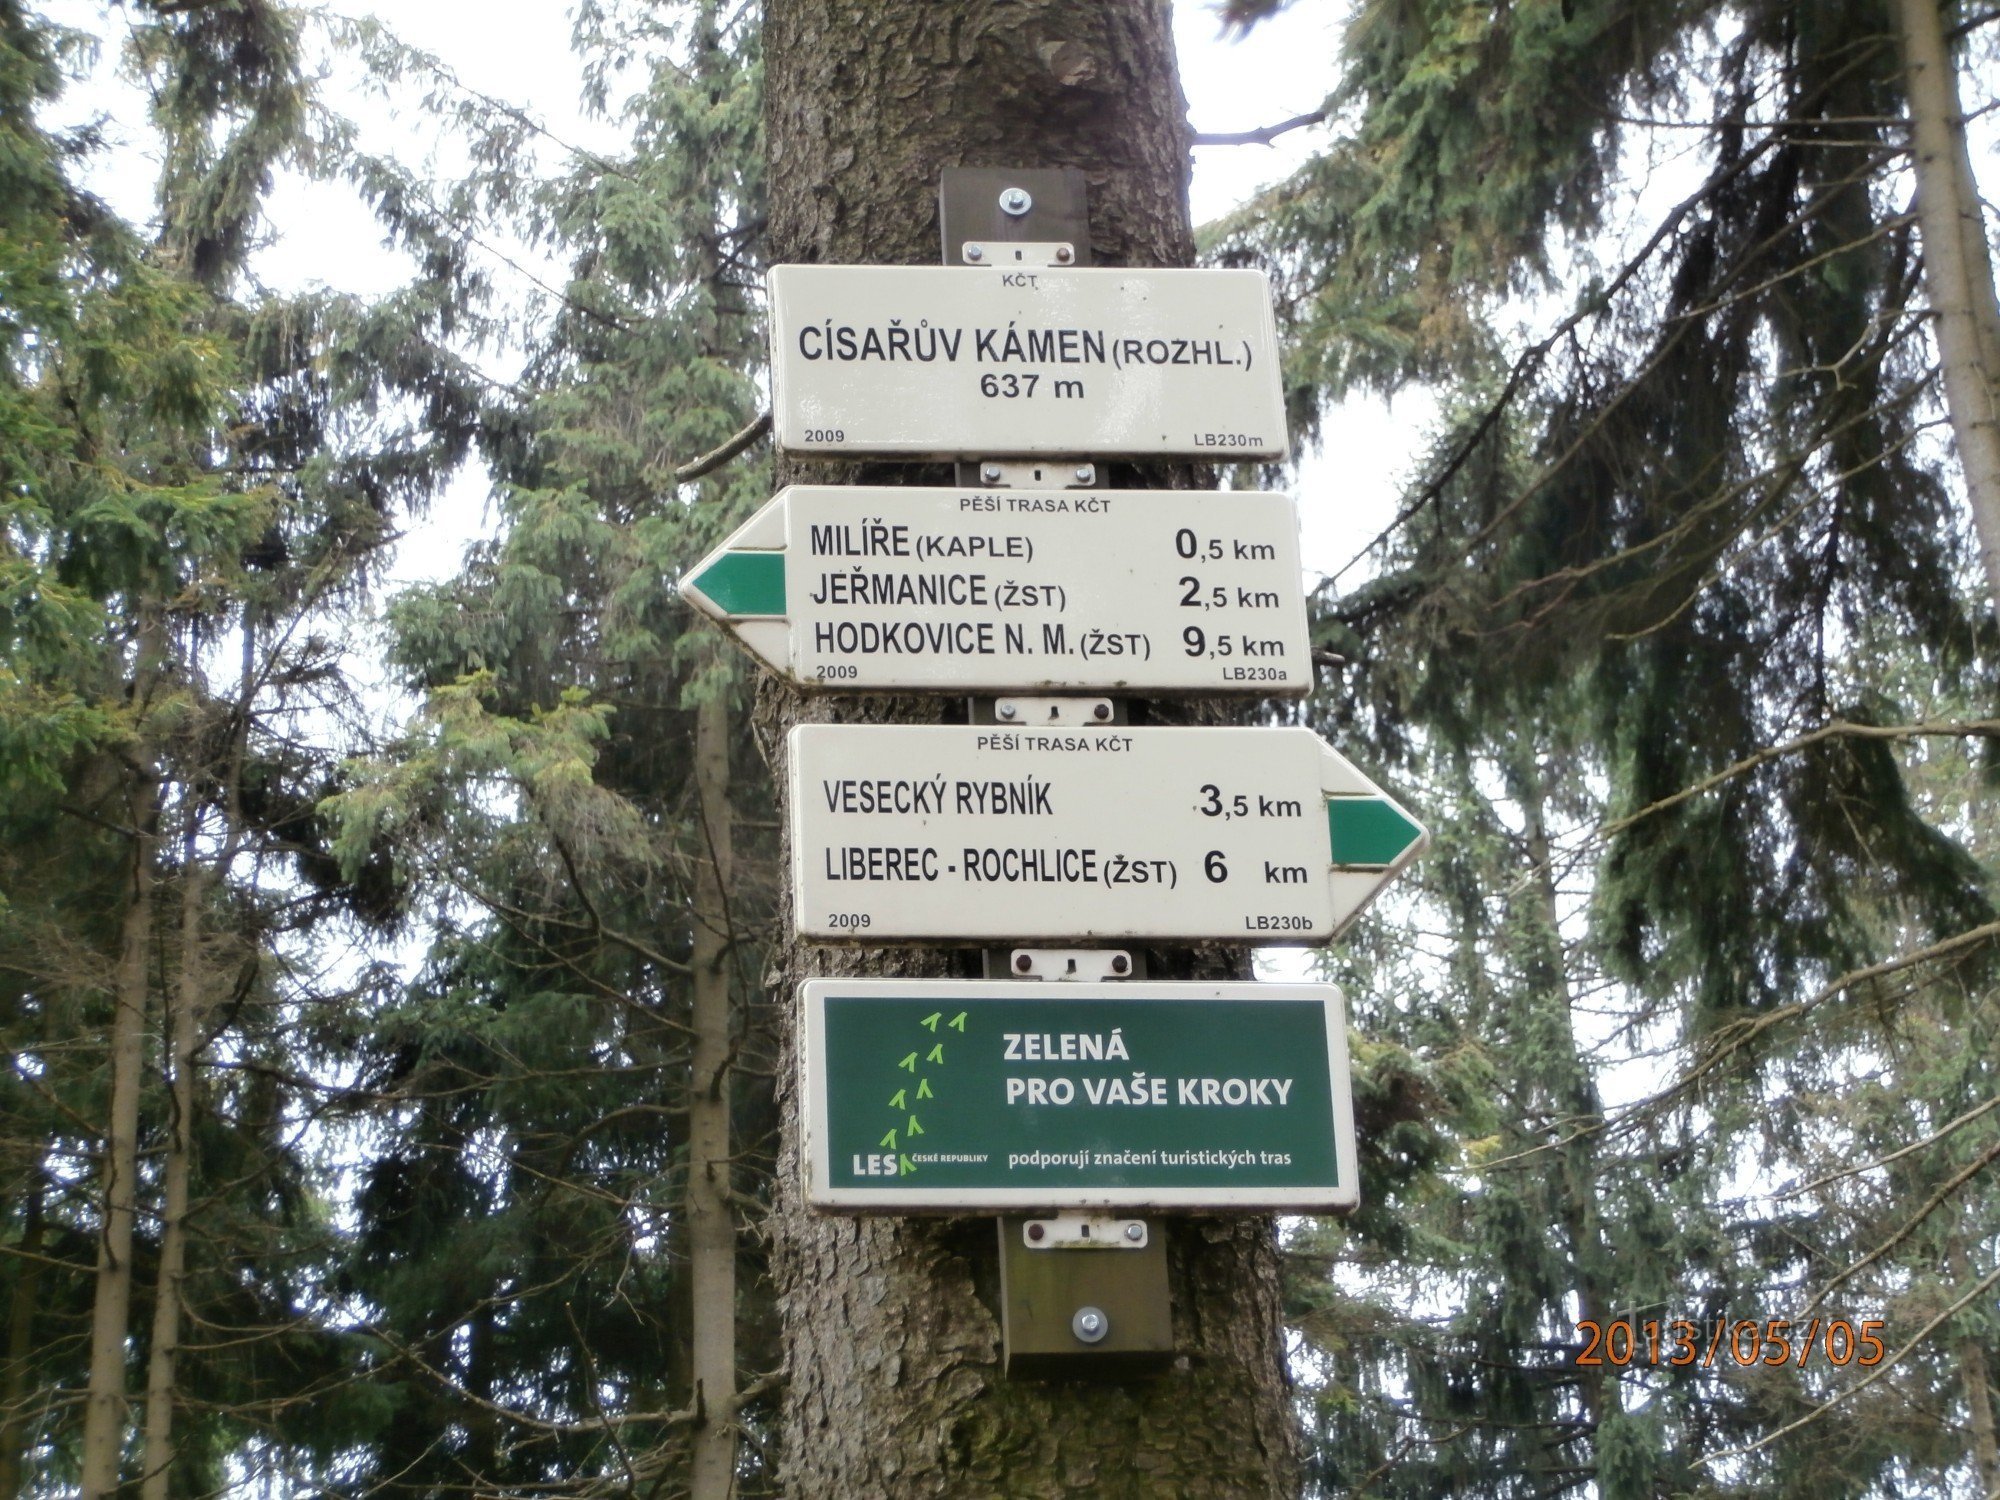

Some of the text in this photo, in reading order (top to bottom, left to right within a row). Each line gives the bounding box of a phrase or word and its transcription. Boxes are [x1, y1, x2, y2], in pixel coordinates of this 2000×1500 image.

[1001, 273, 1038, 288] KČT
[799, 318, 1252, 372] CÍSAŘŮV KÁMEN (ROZHL.)
[980, 373, 1085, 399] 637 m
[804, 429, 845, 443] 2009
[1193, 433, 1264, 447] LB230m
[959, 495, 1111, 513] PĚŠÍ TRASA KČT
[811, 517, 1033, 564] MILÍŘE (KAPLE)
[1175, 528, 1276, 564] 0,5 km
[812, 565, 1067, 613] JEŘMANICE (ŽST)
[1178, 575, 1280, 612] 2,5 km
[815, 621, 1152, 662] HODKOVICE N. M. (ŽST)
[1182, 625, 1285, 660] 9,5 km
[815, 665, 859, 680] 2009
[1222, 667, 1287, 681] LB230a
[976, 734, 1134, 753] PĚŠÍ TRASA KČT
[823, 772, 1054, 815] VESECKÝ RYBNÍK
[1199, 783, 1302, 821] 3,5 km
[825, 847, 939, 882] LIBEREC
[963, 847, 1098, 883] ROCHLICE
[1103, 854, 1177, 890] (ŽST)
[1204, 850, 1308, 884] 6 km
[827, 913, 872, 929] 2009
[1245, 915, 1313, 930] LB230b
[1003, 1027, 1130, 1061] ZELENÁ
[1006, 1071, 1293, 1106] PRO VAŠE KROKY
[911, 1152, 989, 1163] ČESKÉ REPUBLIKY
[1008, 1149, 1292, 1170] podporují značení turistických tras
